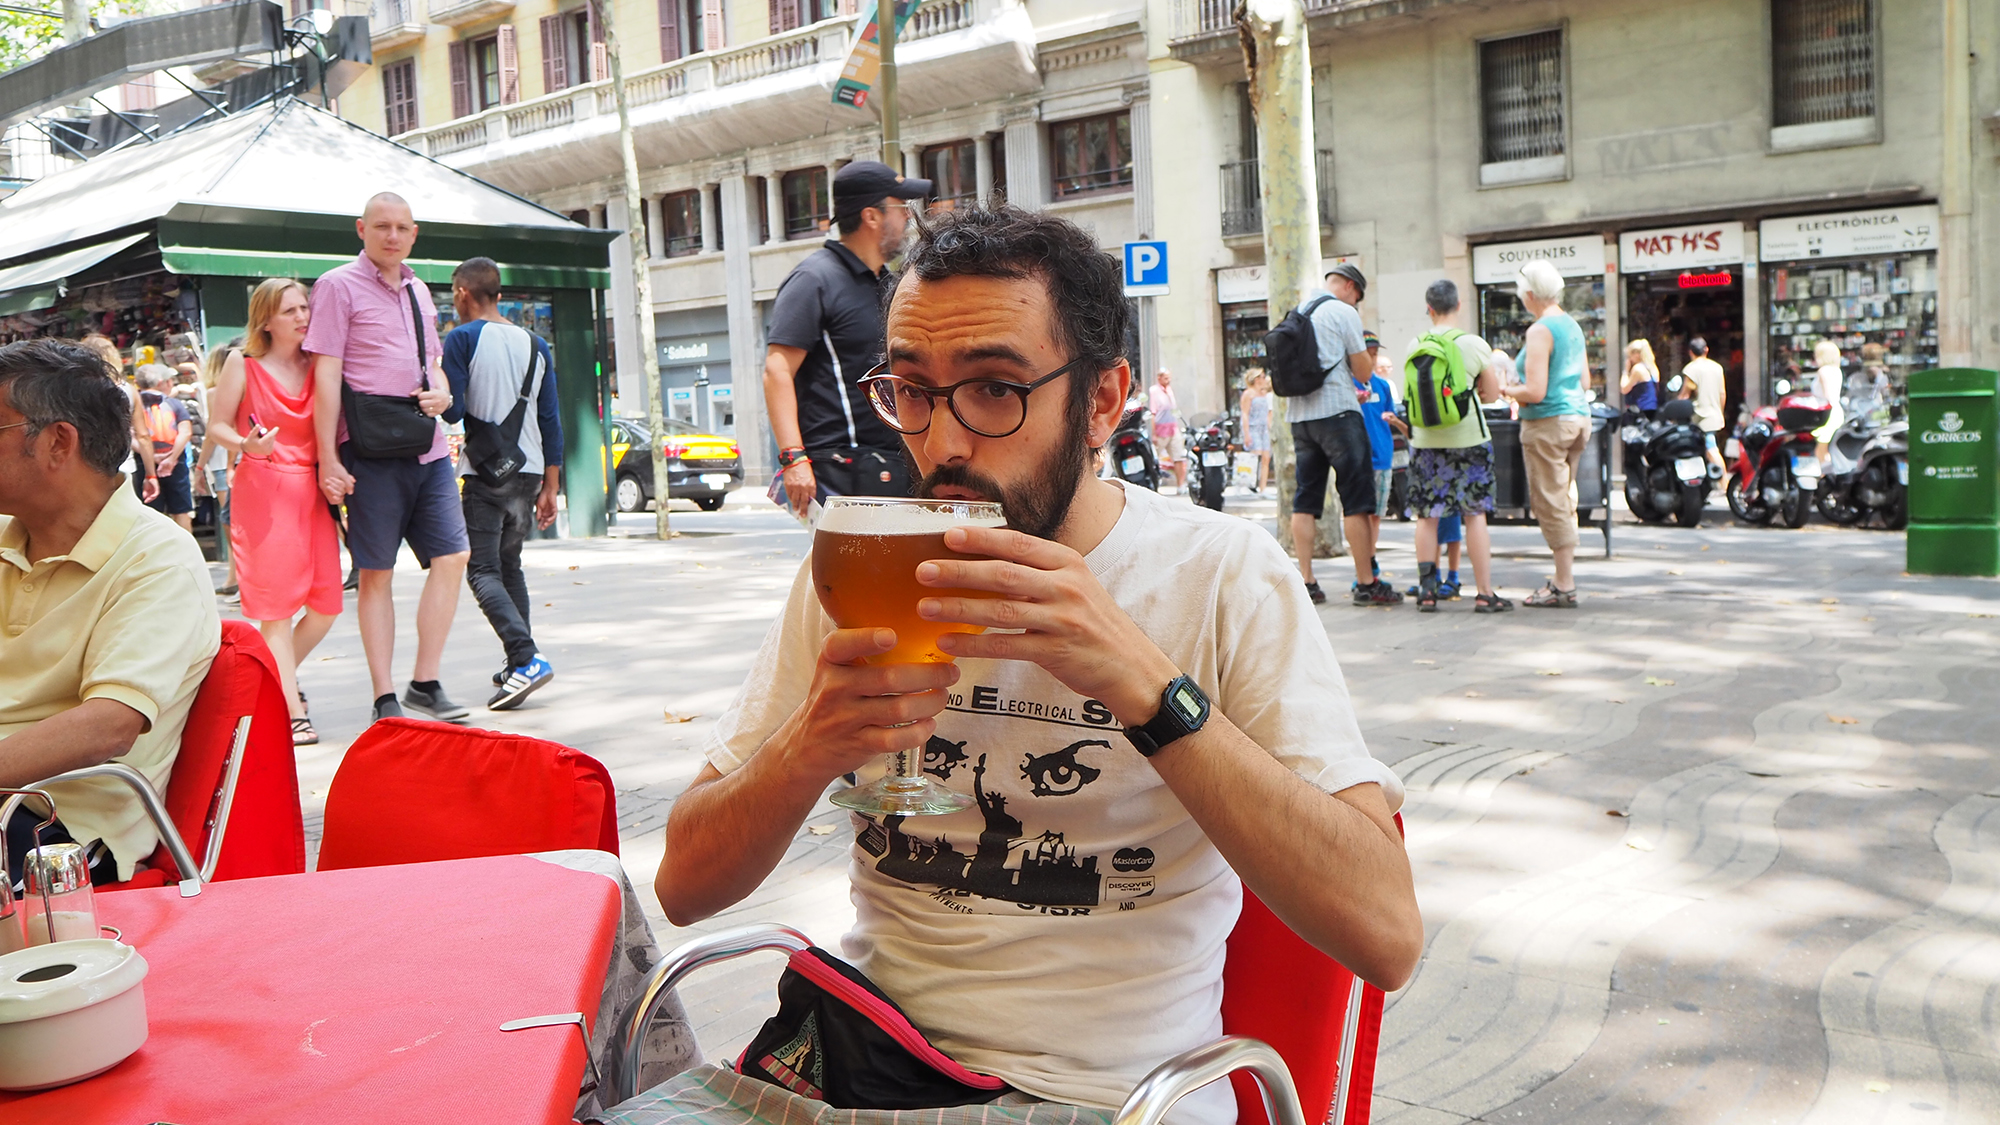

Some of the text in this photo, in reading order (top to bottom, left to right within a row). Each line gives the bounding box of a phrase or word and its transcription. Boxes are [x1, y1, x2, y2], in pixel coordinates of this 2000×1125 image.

[1132, 246, 1160, 282] P
[1498, 246, 1576, 263] SOUVENIRS
[1921, 430, 1981, 443] CORREOS
[946, 693, 963, 707] ND
[971, 685, 1077, 721] ELECTRICAL
[1113, 857, 1154, 865] MasterCard
[1108, 881, 1152, 889] DISCOVER
[929, 893, 1136, 915] PAYMENTS AND
[766, 1060, 818, 1098] NIKE
